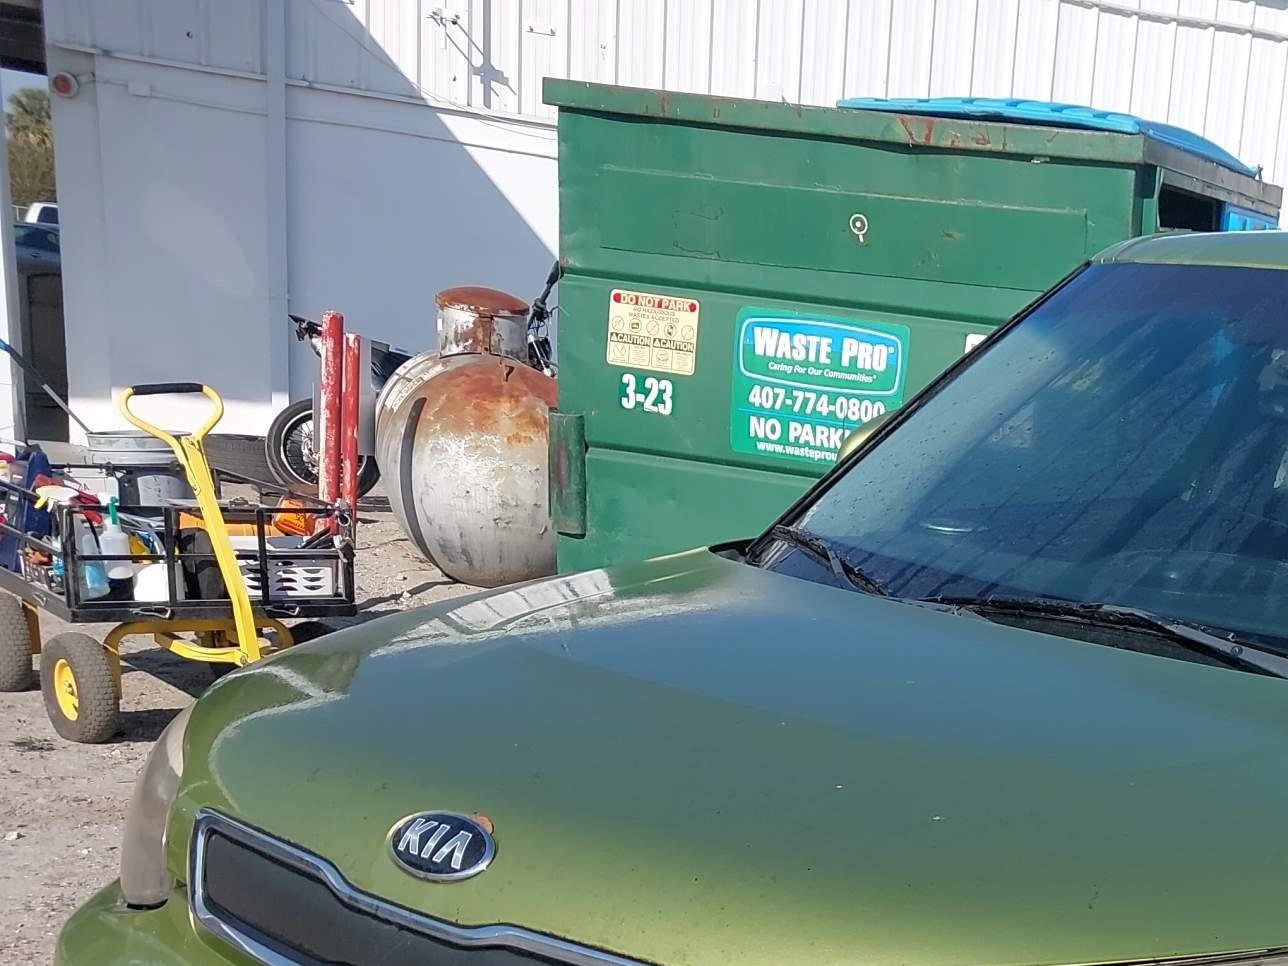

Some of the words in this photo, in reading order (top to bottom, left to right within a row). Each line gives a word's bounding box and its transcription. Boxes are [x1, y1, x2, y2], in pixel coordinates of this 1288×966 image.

[620, 293, 636, 305] DO
[638, 295, 660, 309] NOT
[661, 298, 689, 312] PARK
[617, 333, 650, 347] CAUTION
[660, 340, 693, 353] CAUTION
[753, 326, 832, 365] WASTE
[768, 361, 793, 374] Caring
[793, 364, 807, 374] For
[807, 366, 823, 376] Our
[823, 369, 873, 383] Communities
[621, 373, 673, 415] 3-23
[748, 384, 886, 423] 407-774-0800
[749, 415, 782, 441] NO
[397, 817, 473, 870] KIA
